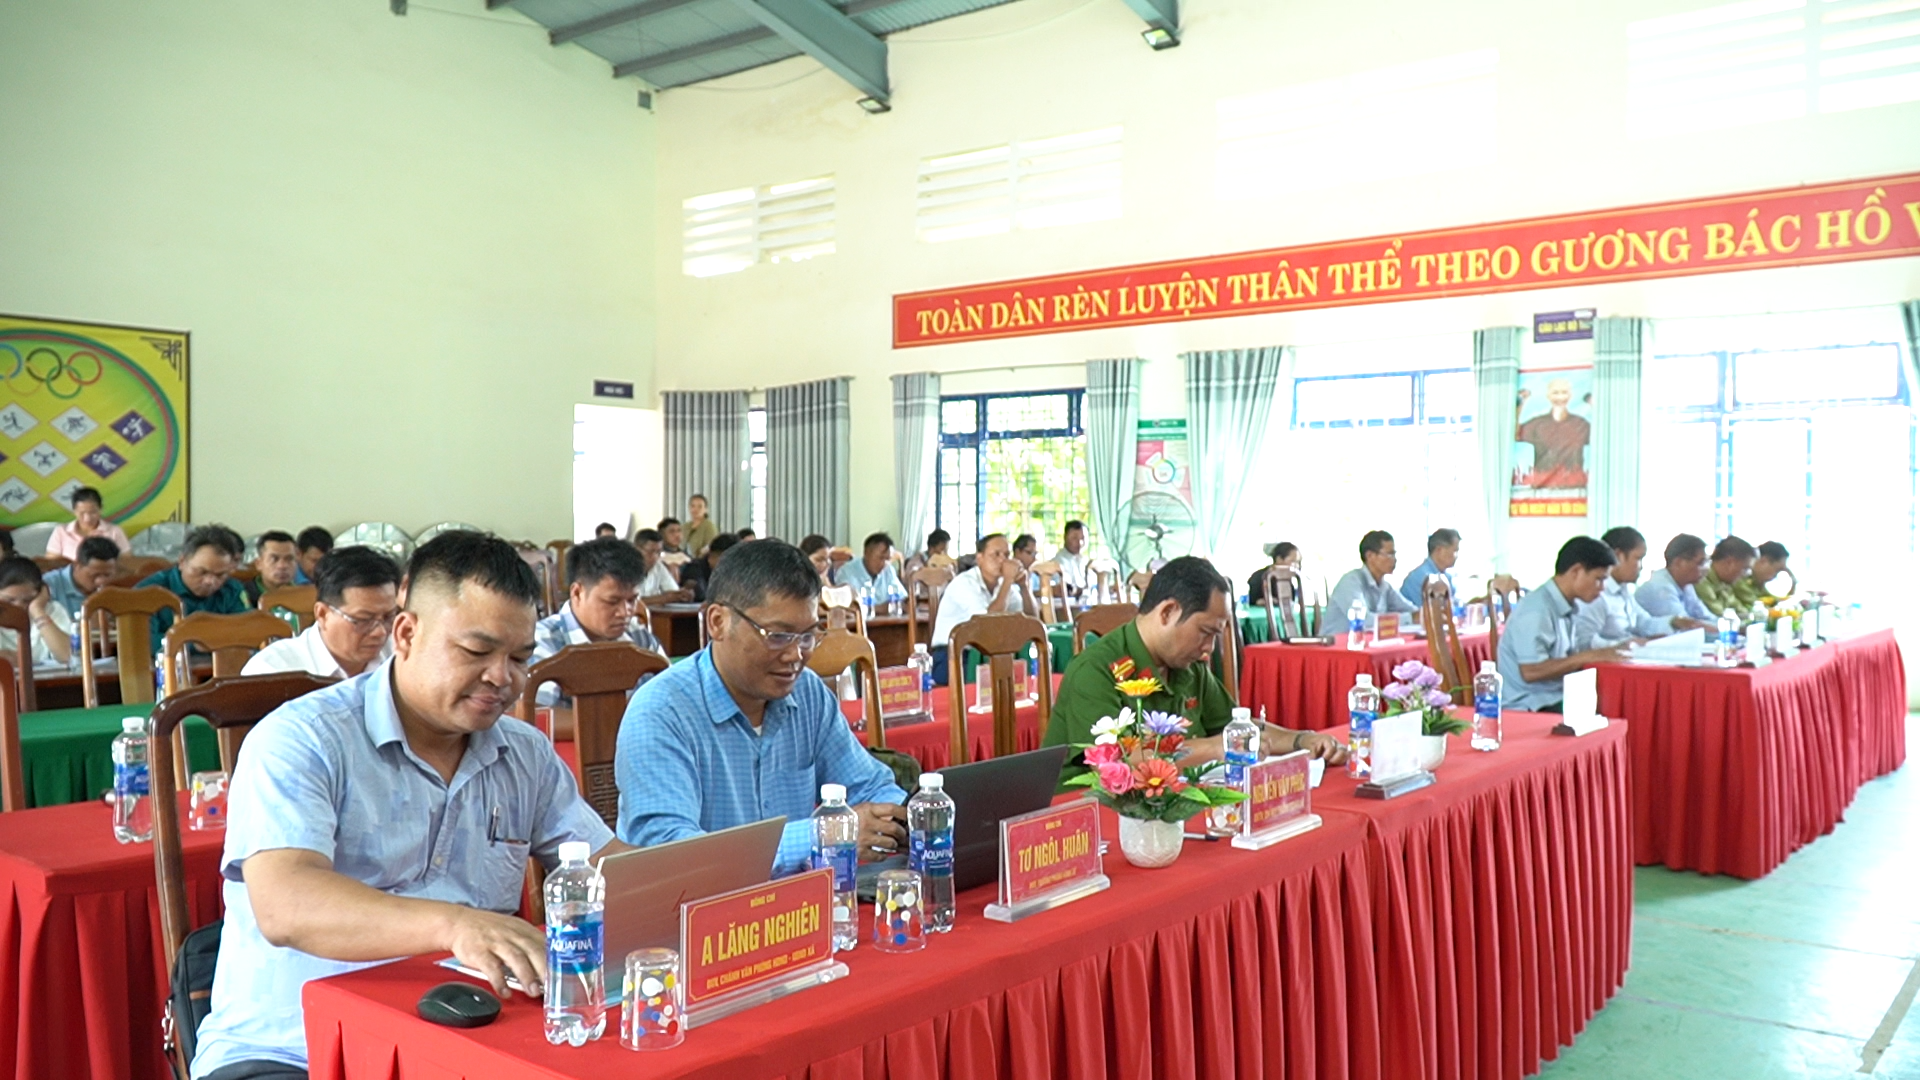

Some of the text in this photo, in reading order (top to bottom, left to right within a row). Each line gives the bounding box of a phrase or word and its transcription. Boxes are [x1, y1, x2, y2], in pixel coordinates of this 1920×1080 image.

[917, 302, 984, 337] TOÀN
[990, 291, 1046, 329] DÂN
[1053, 285, 1111, 324] RÈN
[1118, 271, 1220, 317] LUYỆN
[1227, 260, 1320, 305] THÂN
[1328, 238, 1403, 295] THỂ
[1411, 245, 1521, 287] THEO
[1530, 227, 1693, 276] GƯƠNG
[1704, 207, 1802, 260] BÁC
[1815, 186, 1893, 250] HỒ
[550, 938, 594, 953] AQUAFINA
[701, 901, 820, 966] A LĂNG NGHIÊN
